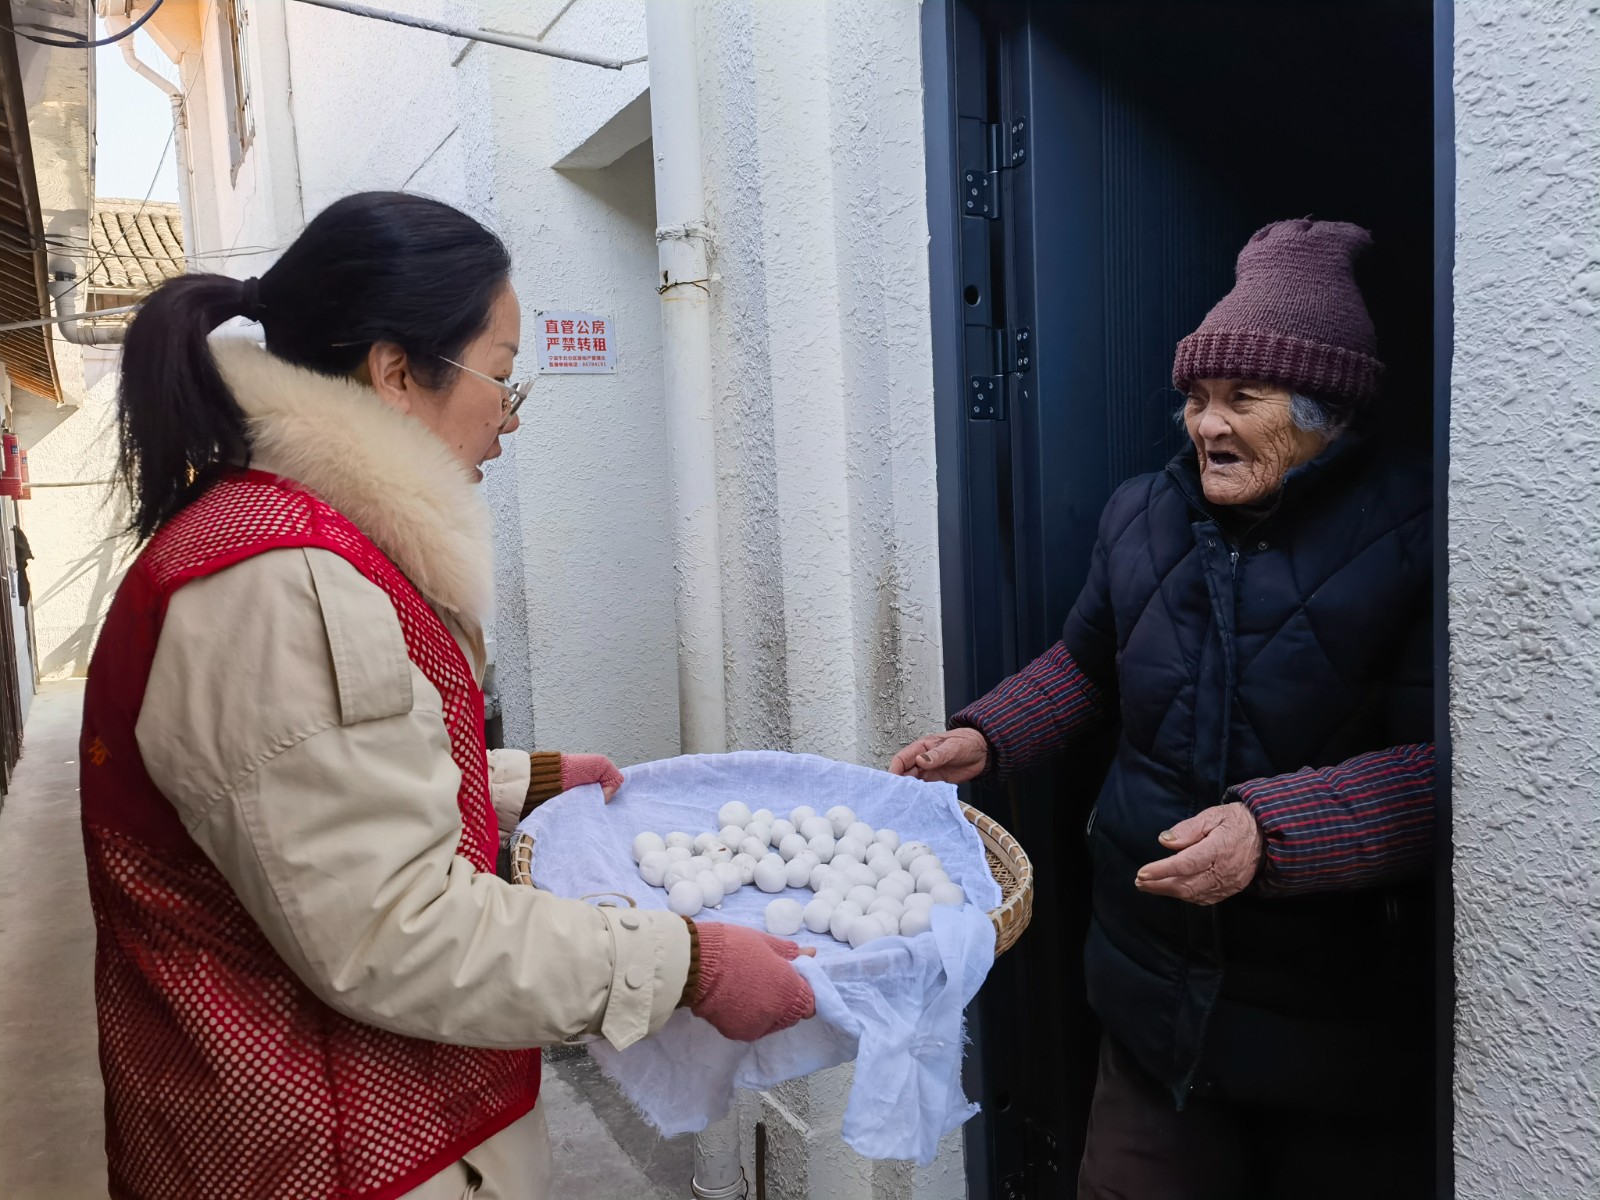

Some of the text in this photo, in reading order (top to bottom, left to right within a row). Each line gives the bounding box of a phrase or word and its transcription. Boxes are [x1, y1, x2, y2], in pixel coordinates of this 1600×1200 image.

[544, 319, 605, 334] 直管公房
[546, 337, 607, 352] 严禁转租
